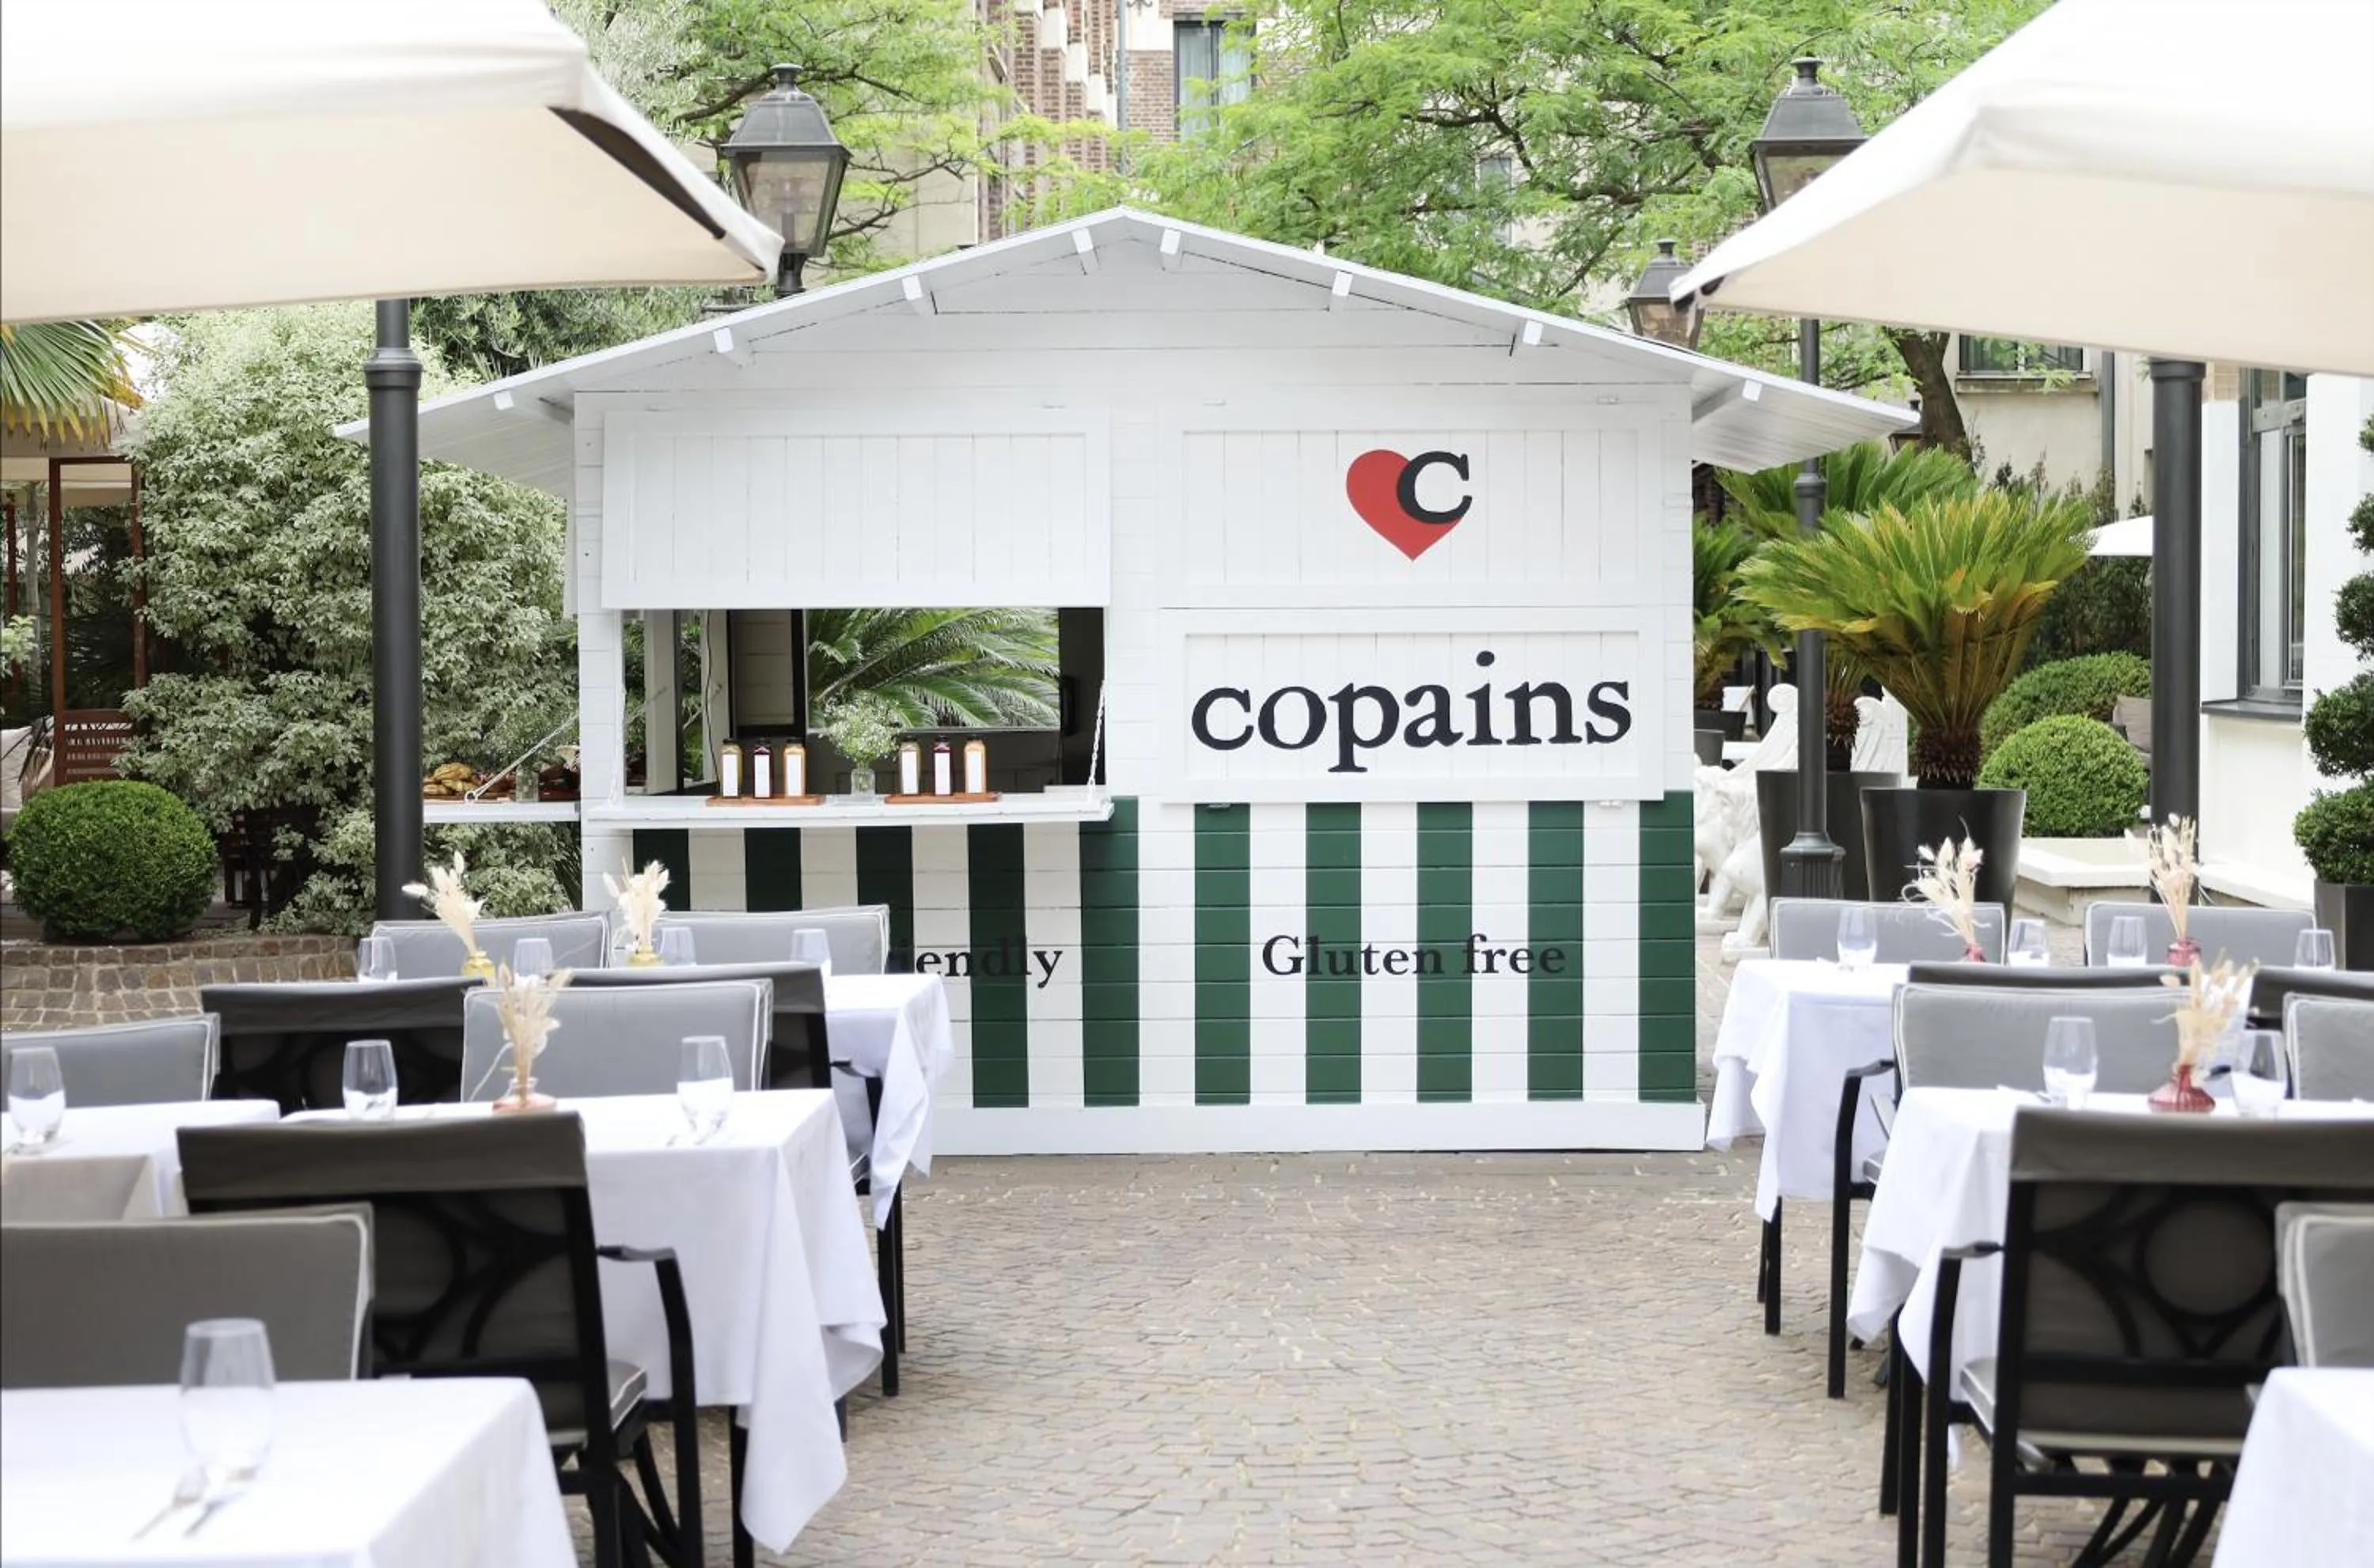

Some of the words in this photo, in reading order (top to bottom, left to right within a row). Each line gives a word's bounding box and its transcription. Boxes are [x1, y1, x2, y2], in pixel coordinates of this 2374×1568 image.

[1191, 650, 1631, 773] copains
[1262, 934, 1445, 975] Gluten
[1463, 933, 1566, 974] free
